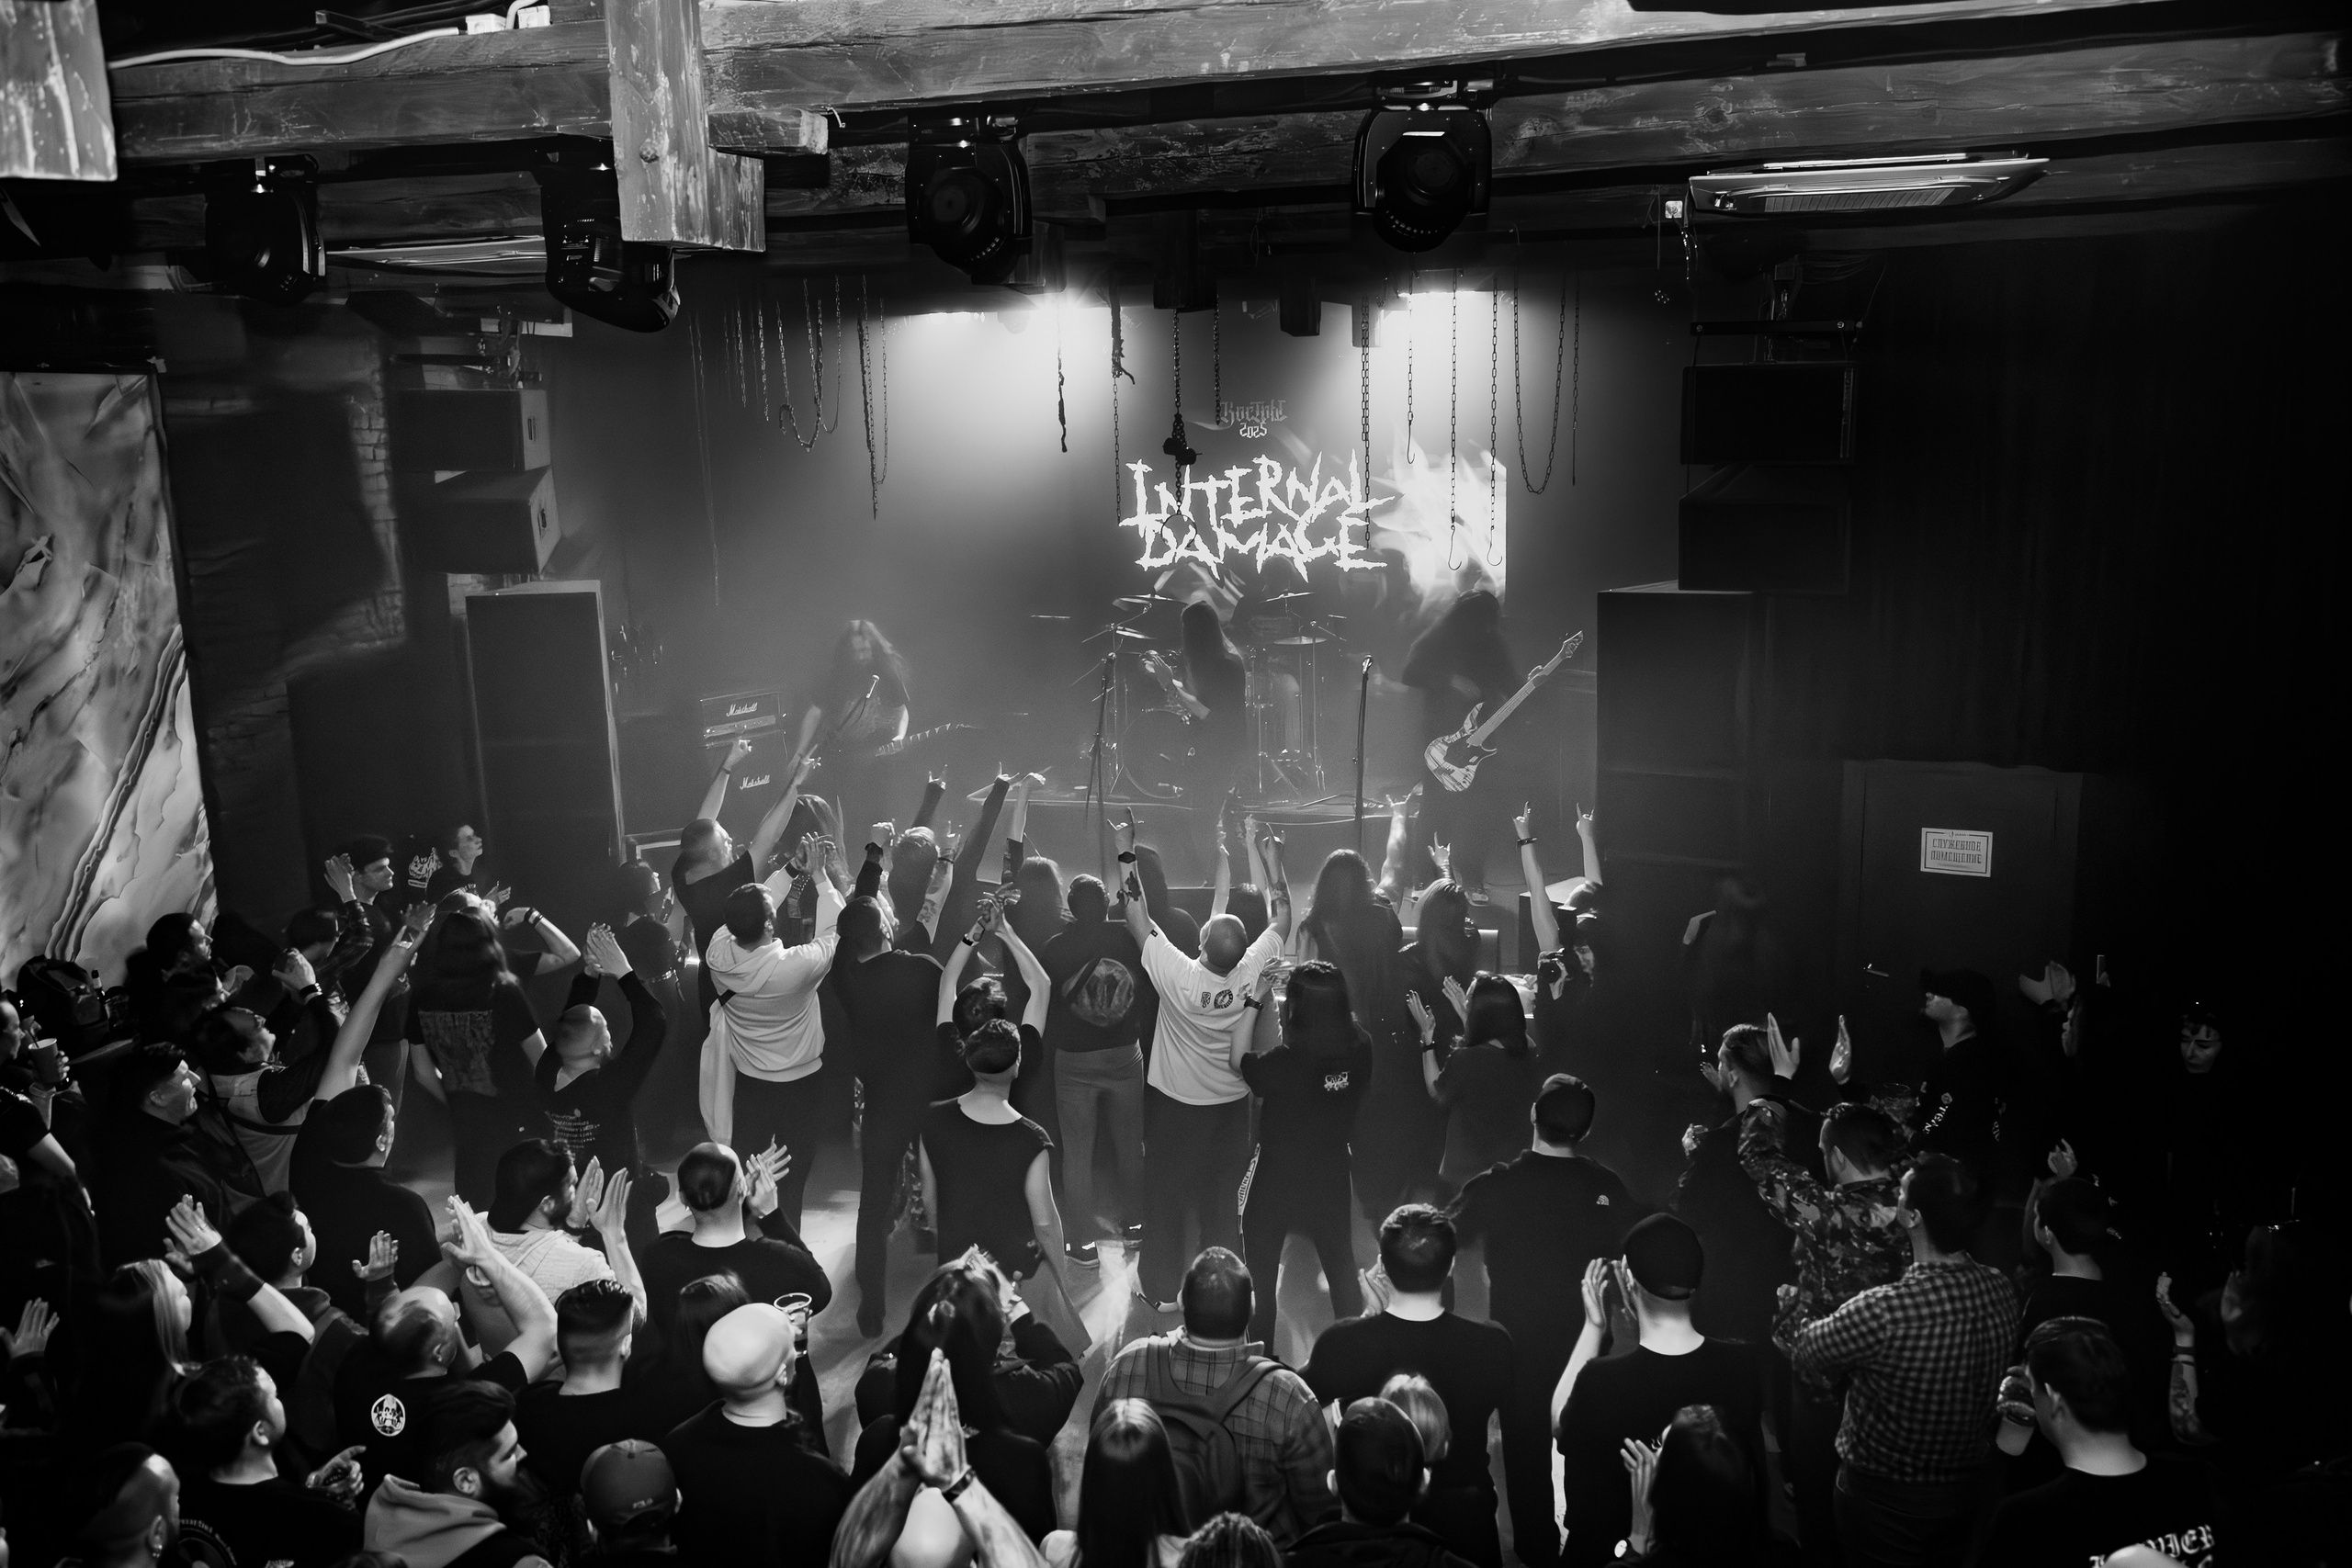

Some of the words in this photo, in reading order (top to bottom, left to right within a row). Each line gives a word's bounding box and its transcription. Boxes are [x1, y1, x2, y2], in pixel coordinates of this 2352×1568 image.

[1239, 422, 1267, 438] 2025
[1119, 448, 1395, 536] INTERNAL
[1135, 513, 1387, 582] DAMAGE
[726, 702, 758, 716] Marshall
[739, 774, 770, 790] Marshall
[1932, 838, 1982, 852] СЛУЖЕБНОЕ
[1930, 851, 1982, 863] ПОМЕЩЕНИЕ
